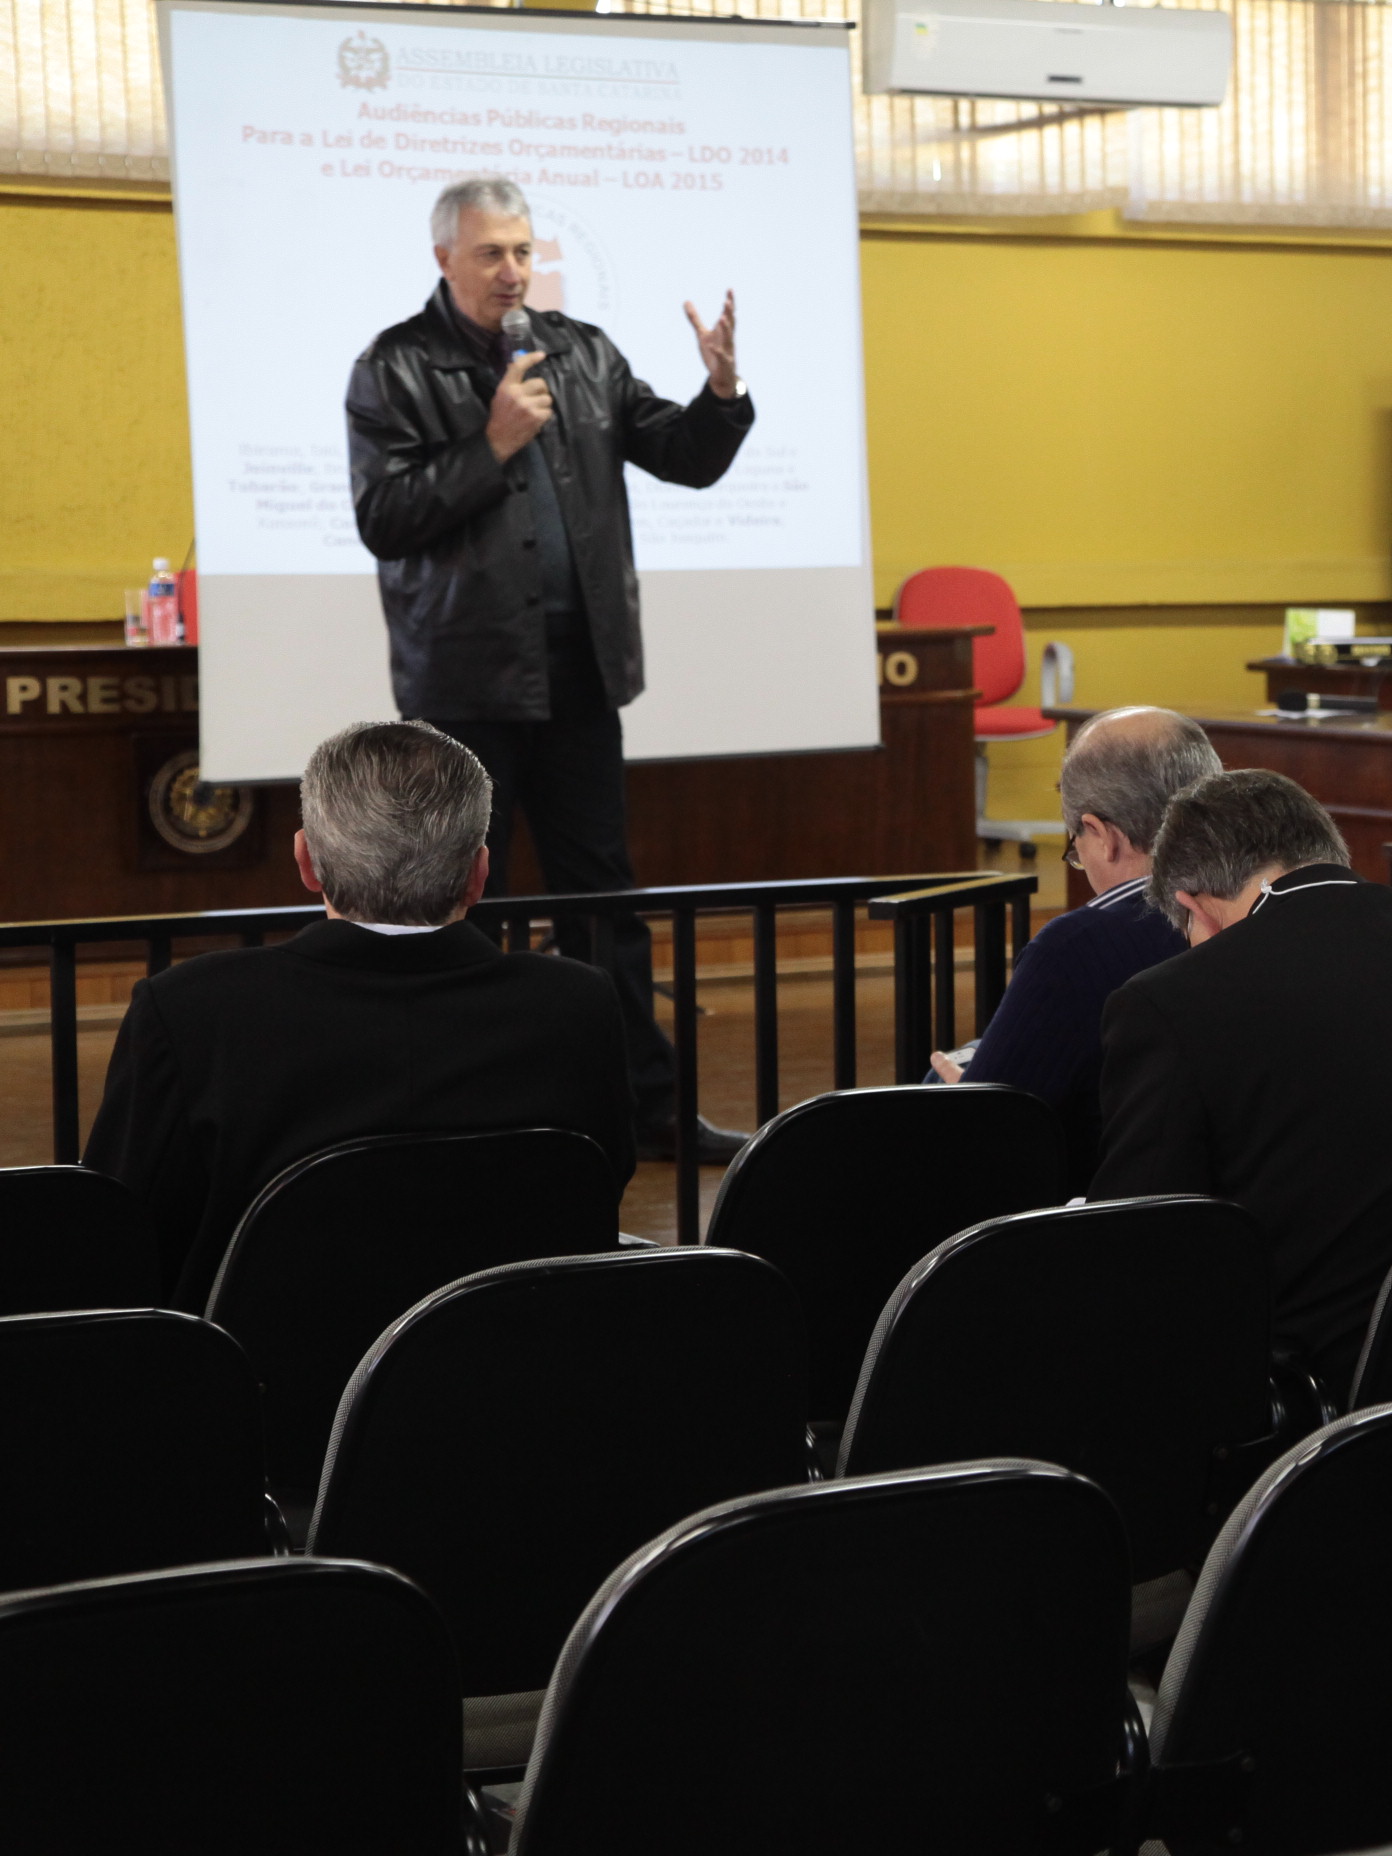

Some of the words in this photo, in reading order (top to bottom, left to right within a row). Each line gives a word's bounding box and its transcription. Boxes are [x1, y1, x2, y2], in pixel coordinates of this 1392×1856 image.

[356, 102, 482, 127] Audiências
[487, 106, 578, 131] Públicas
[581, 113, 687, 136] Regionais
[242, 125, 293, 146] Para
[299, 131, 313, 147] a
[322, 127, 353, 148] Lei
[360, 128, 386, 149] de
[395, 132, 503, 155] Diretrizes
[508, 138, 668, 163] Orçamentárias
[688, 145, 732, 165] LDO
[738, 145, 790, 165] 2014
[321, 163, 335, 178] e
[340, 158, 371, 178] Lei
[538, 168, 600, 188] Anual
[621, 169, 666, 189] LOA
[671, 172, 724, 191] 2015
